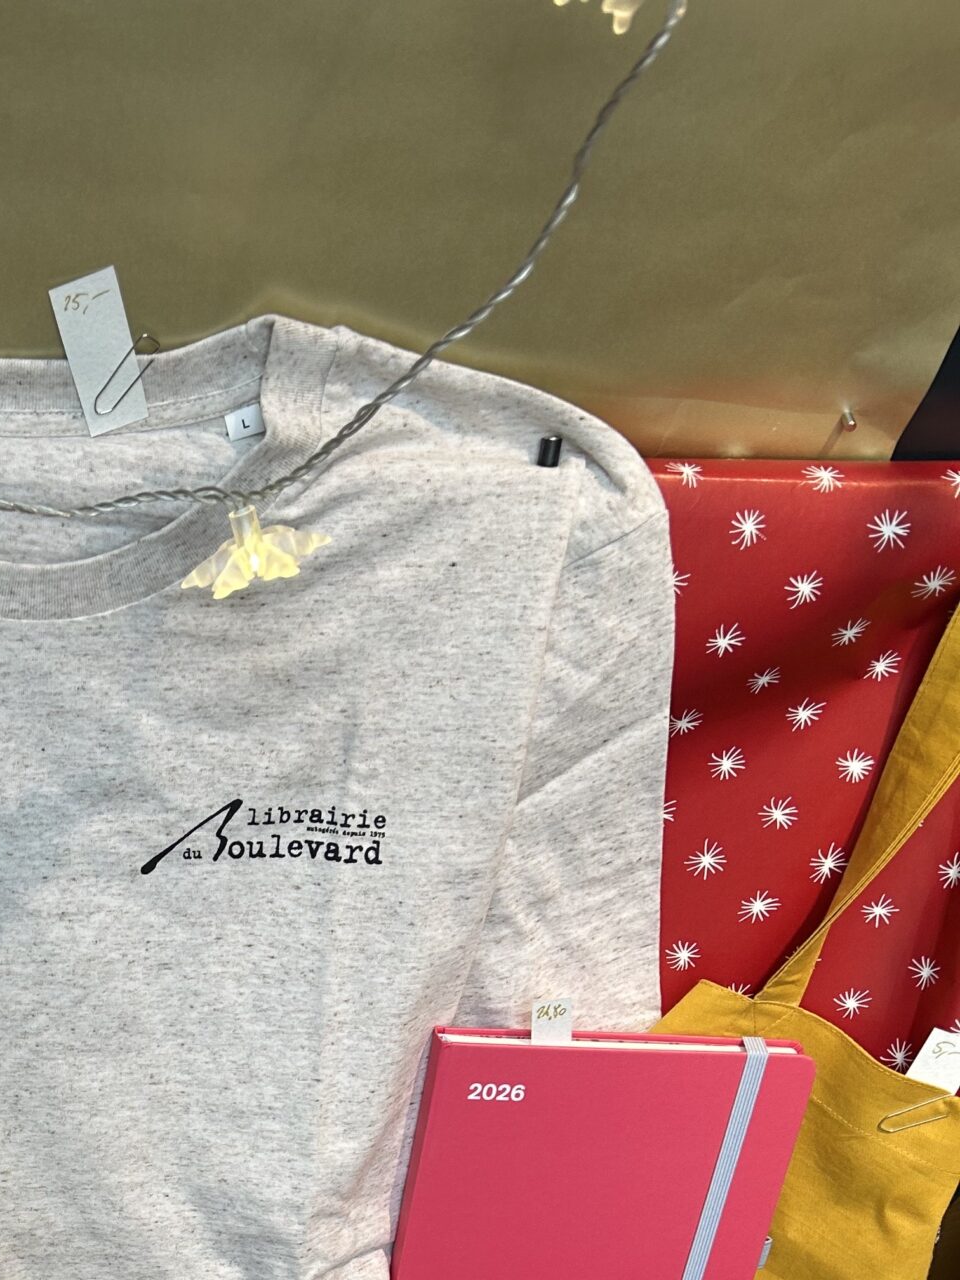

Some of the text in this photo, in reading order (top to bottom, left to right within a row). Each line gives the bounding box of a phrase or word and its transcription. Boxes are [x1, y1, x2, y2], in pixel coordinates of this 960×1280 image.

[241, 418, 250, 429] L
[247, 806, 387, 829] librairie
[183, 848, 203, 860] du
[467, 1083, 526, 1101] 2026
